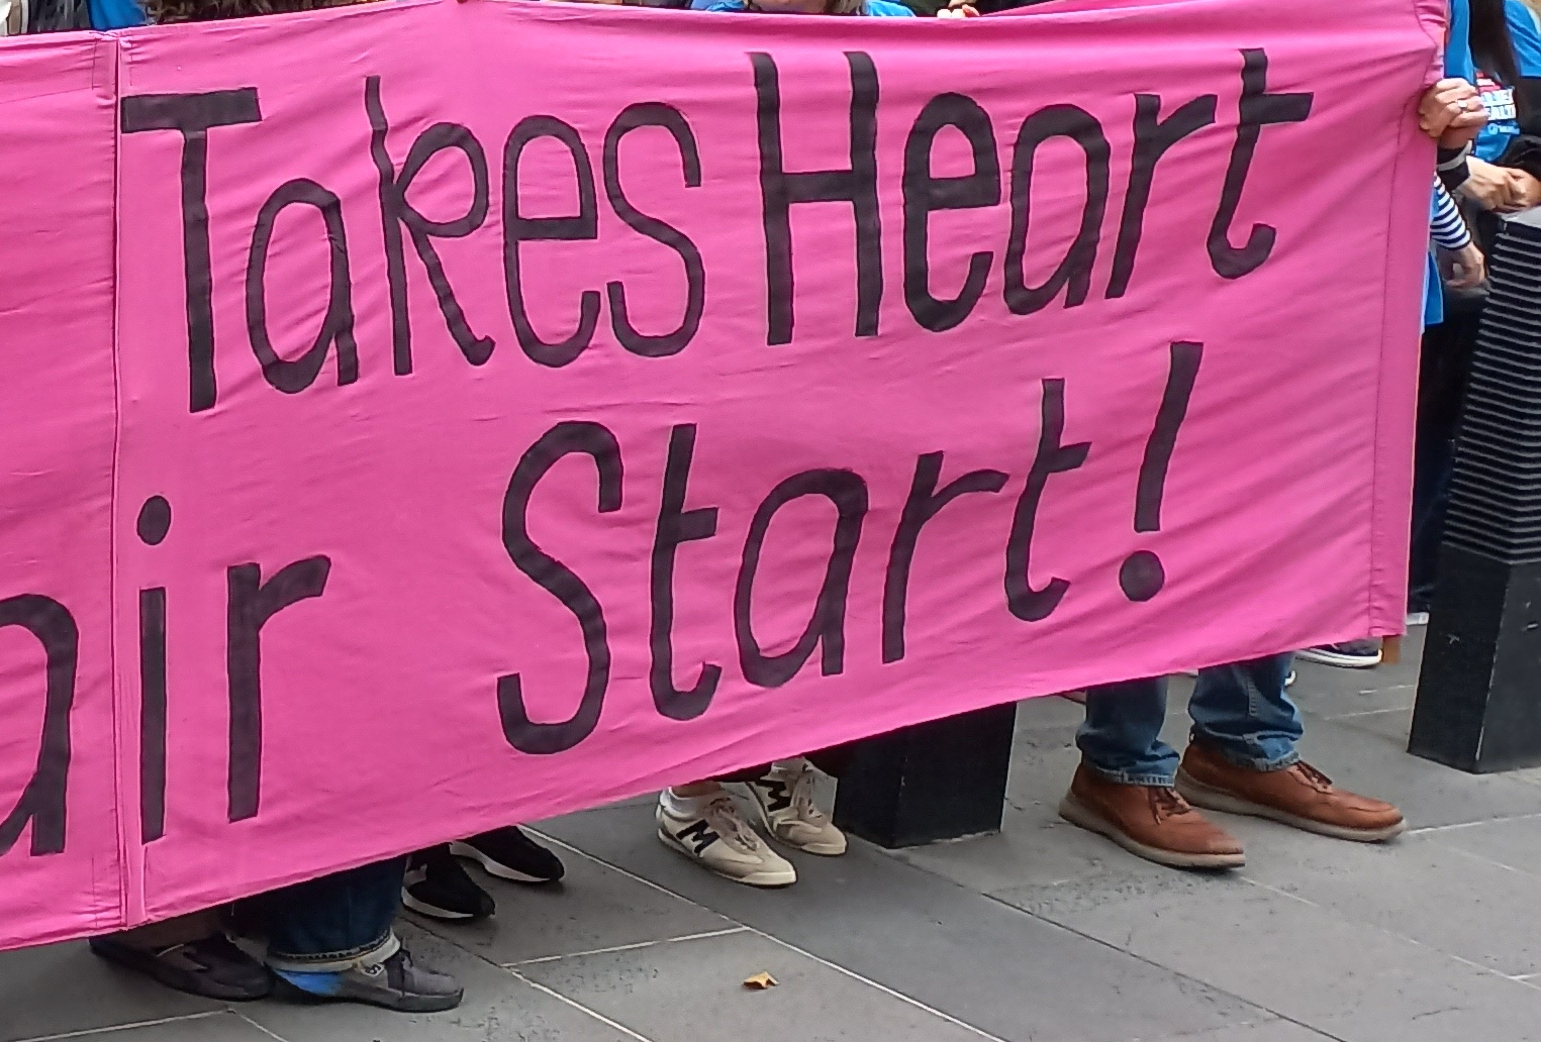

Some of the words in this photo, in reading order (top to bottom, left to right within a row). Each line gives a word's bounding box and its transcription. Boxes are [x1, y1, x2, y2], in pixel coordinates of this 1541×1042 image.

[121, 75, 703, 414] Takes
[753, 46, 1313, 346] Heart
[497, 341, 1204, 755] Start!
